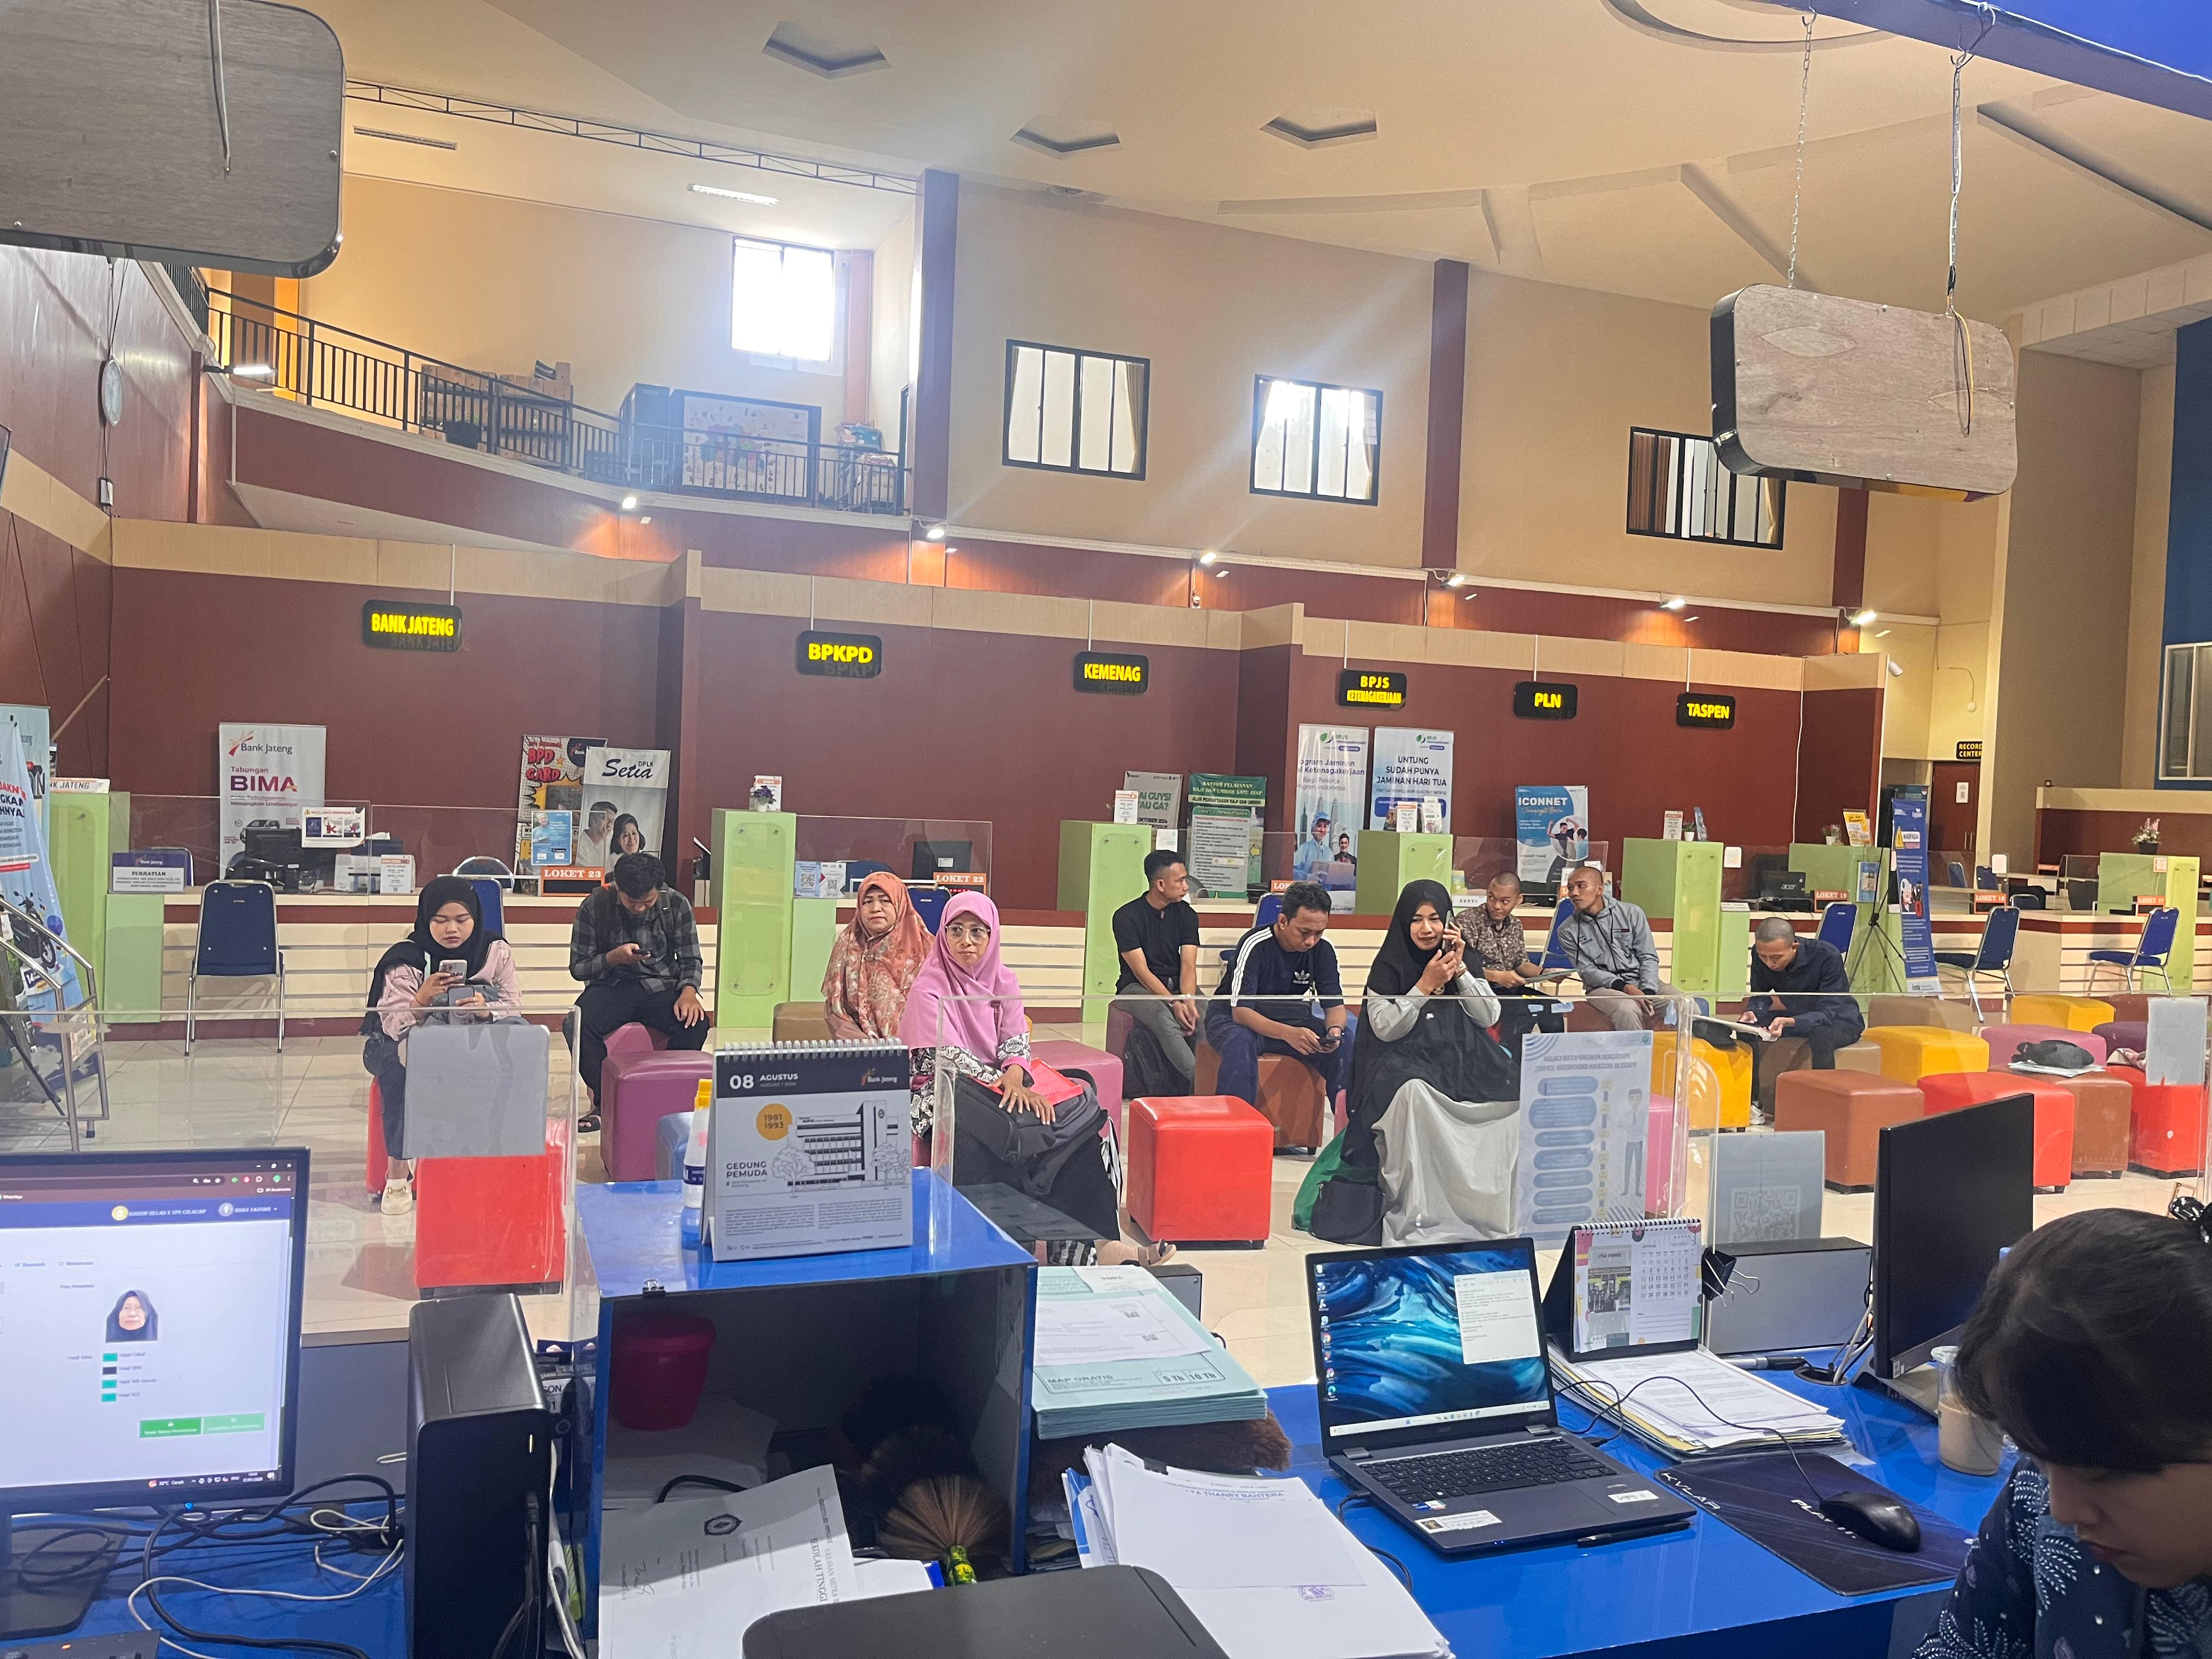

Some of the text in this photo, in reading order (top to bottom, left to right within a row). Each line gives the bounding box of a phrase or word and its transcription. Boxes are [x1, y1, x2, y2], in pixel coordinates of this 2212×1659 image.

[371, 613, 454, 636] BANK JATENG
[808, 643, 873, 663] BPKPD
[1084, 663, 1141, 682] KEMENAG
[1360, 675, 1390, 689] BPJS
[1534, 692, 1562, 708] PLN
[1686, 703, 1730, 719] TASPEN
[241, 743, 292, 755] Bank Jateng
[527, 748, 555, 764] BPD
[1398, 756, 1429, 764] UNTUNG
[526, 766, 561, 783] CARD
[602, 759, 653, 779] Setia
[60, 781, 89, 789] JATENG
[230, 775, 298, 792] BIMA
[1376, 776, 1411, 785] JAMINAN
[1138, 792, 1171, 801] AI GUYS!
[1518, 797, 1568, 806] ICONNET
[1153, 802, 1169, 810] GA?
[544, 869, 585, 878] LOKET
[936, 874, 970, 883] LOKET
[729, 1074, 754, 1090] 08
[759, 1073, 799, 1081] AGUSTUS
[764, 1113, 782, 1121] 1981
[764, 1121, 784, 1130] 1993
[726, 1161, 767, 1170] GEDUNG
[726, 1169, 768, 1178] PEMUDA
[825, 1548, 835, 1577] YAYASAN
[810, 1538, 828, 1602] SEKOLAH TINGGI
